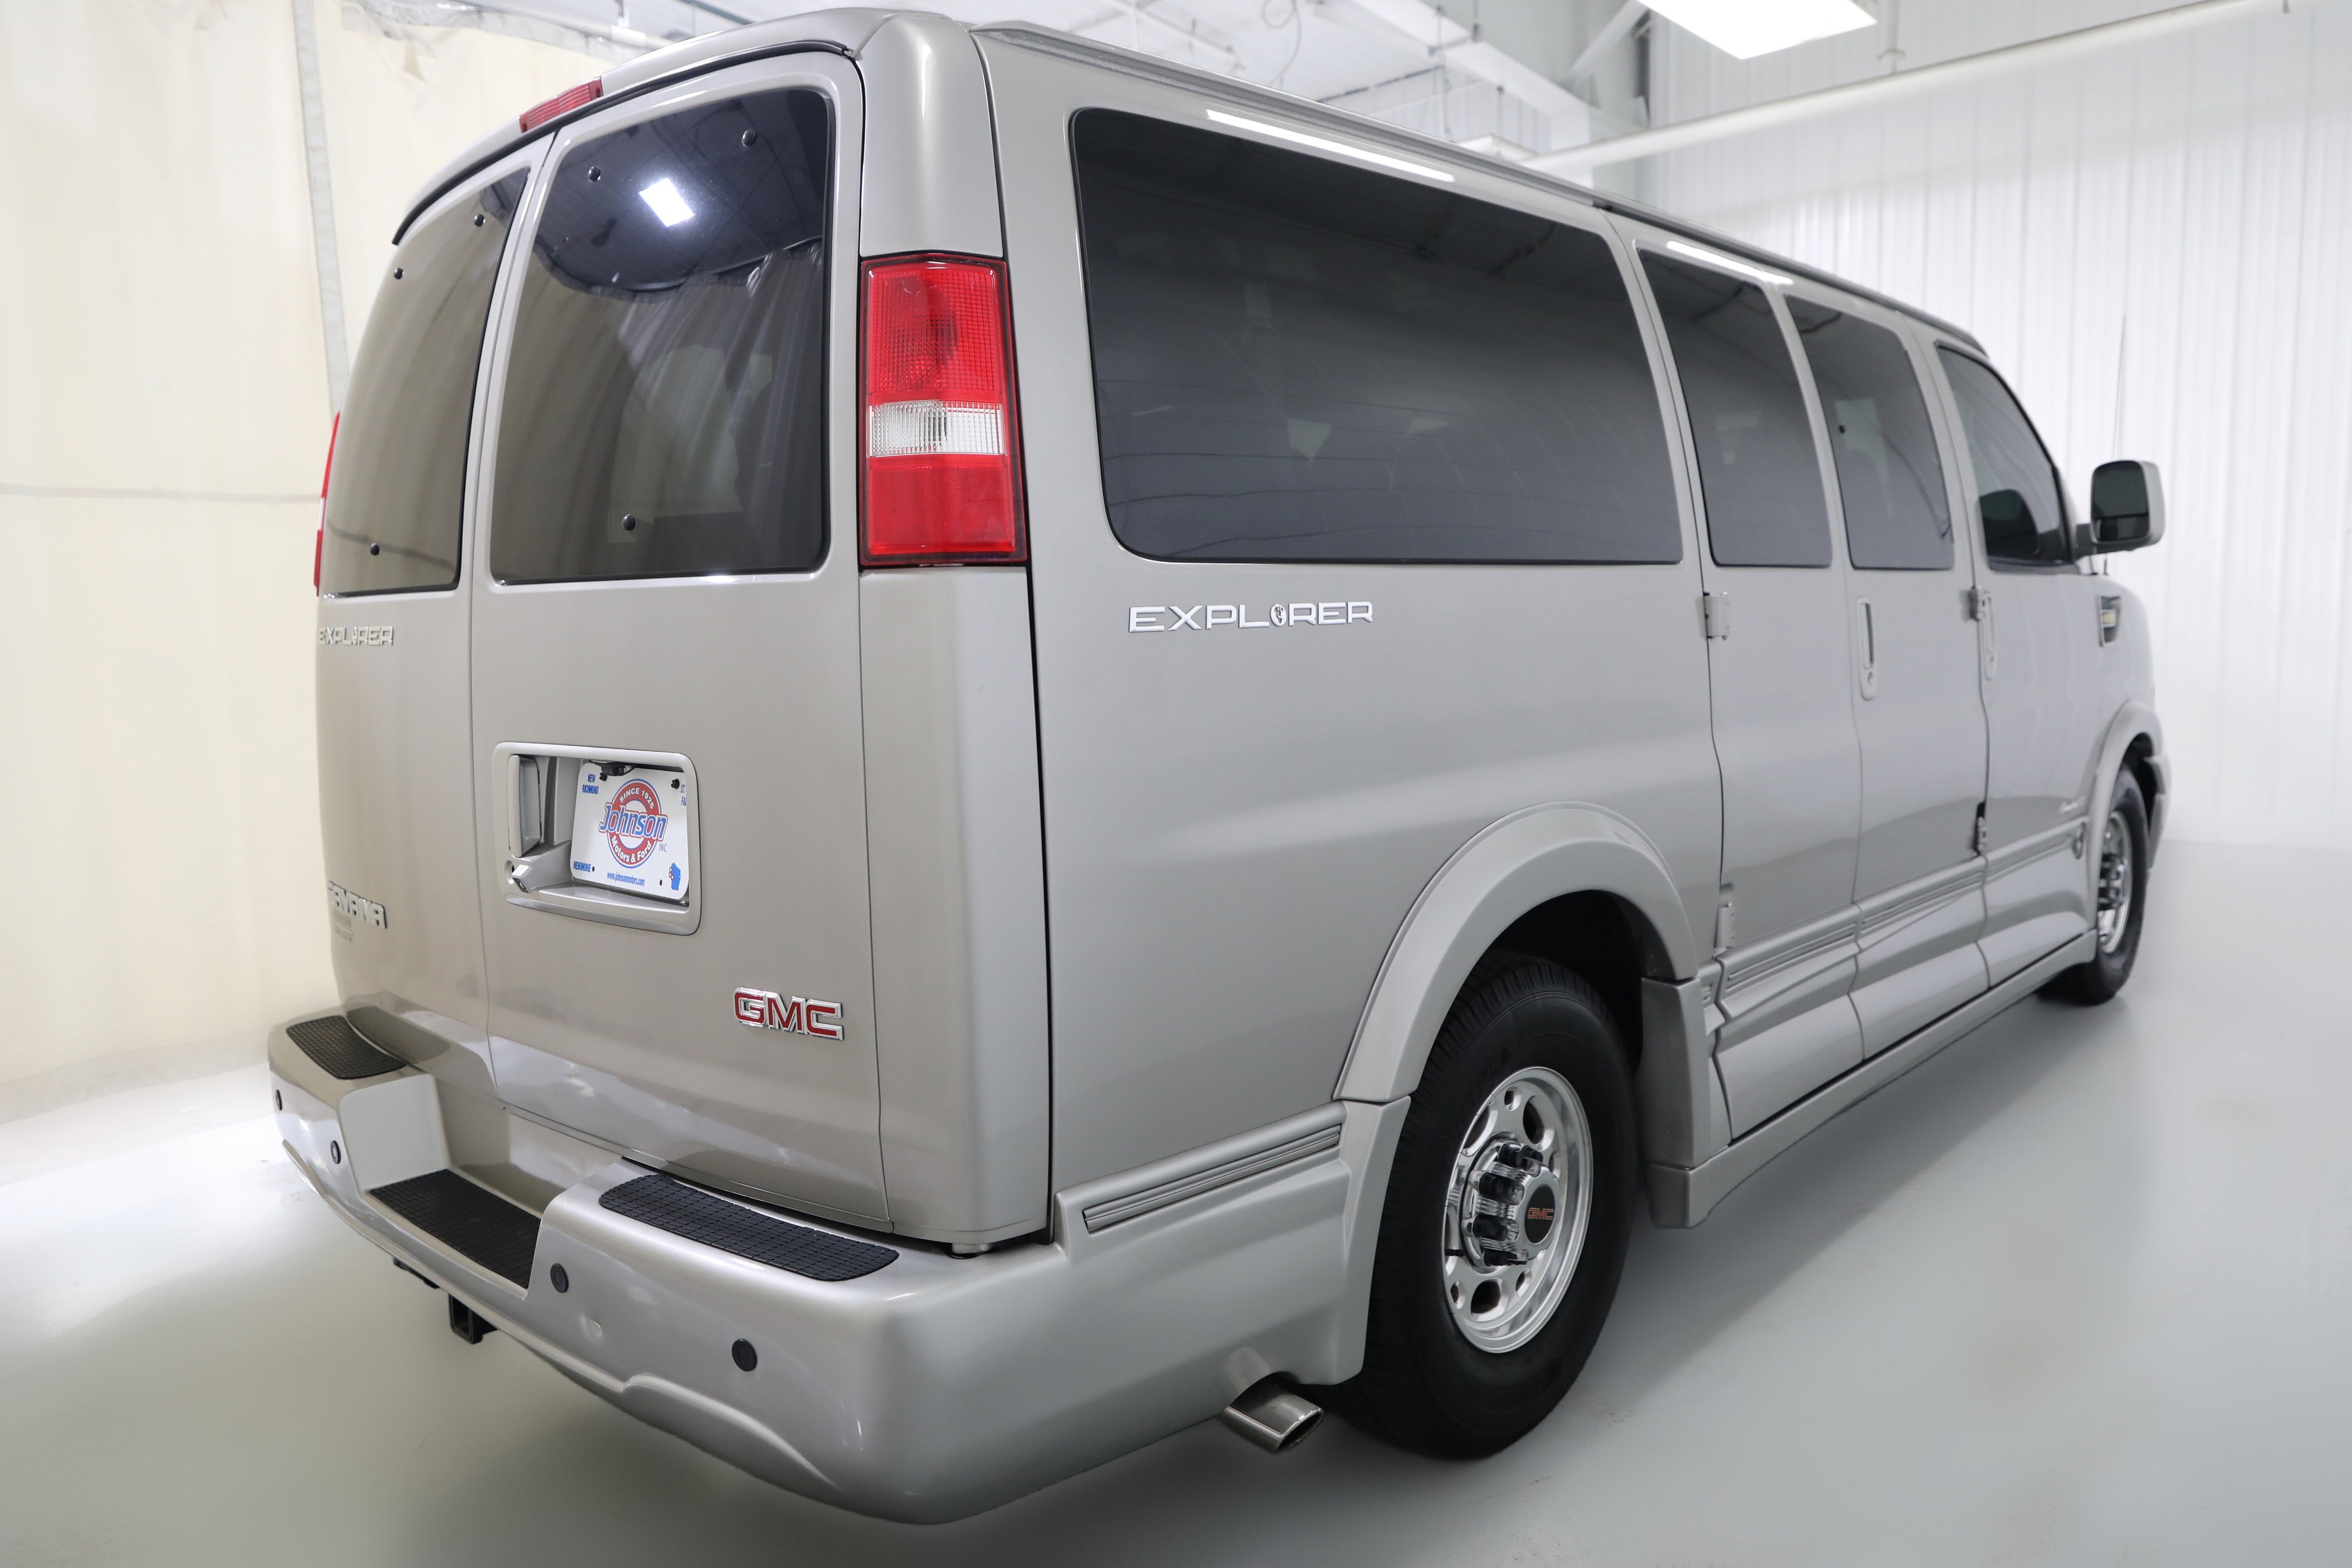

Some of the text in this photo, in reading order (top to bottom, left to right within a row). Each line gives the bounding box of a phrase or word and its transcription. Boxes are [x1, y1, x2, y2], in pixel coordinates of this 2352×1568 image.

[1129, 601, 1373, 633] EXPLORER
[319, 625, 394, 646] EXPLORER
[587, 773, 596, 783] NEW
[619, 787, 654, 810] SINCE 1925
[600, 803, 667, 840] Johnson
[611, 835, 652, 863] Motors & Ford
[607, 871, 645, 886] www.johnsonmotors.com
[733, 987, 844, 1041] GMC
[1527, 1207, 1554, 1220] GMC
